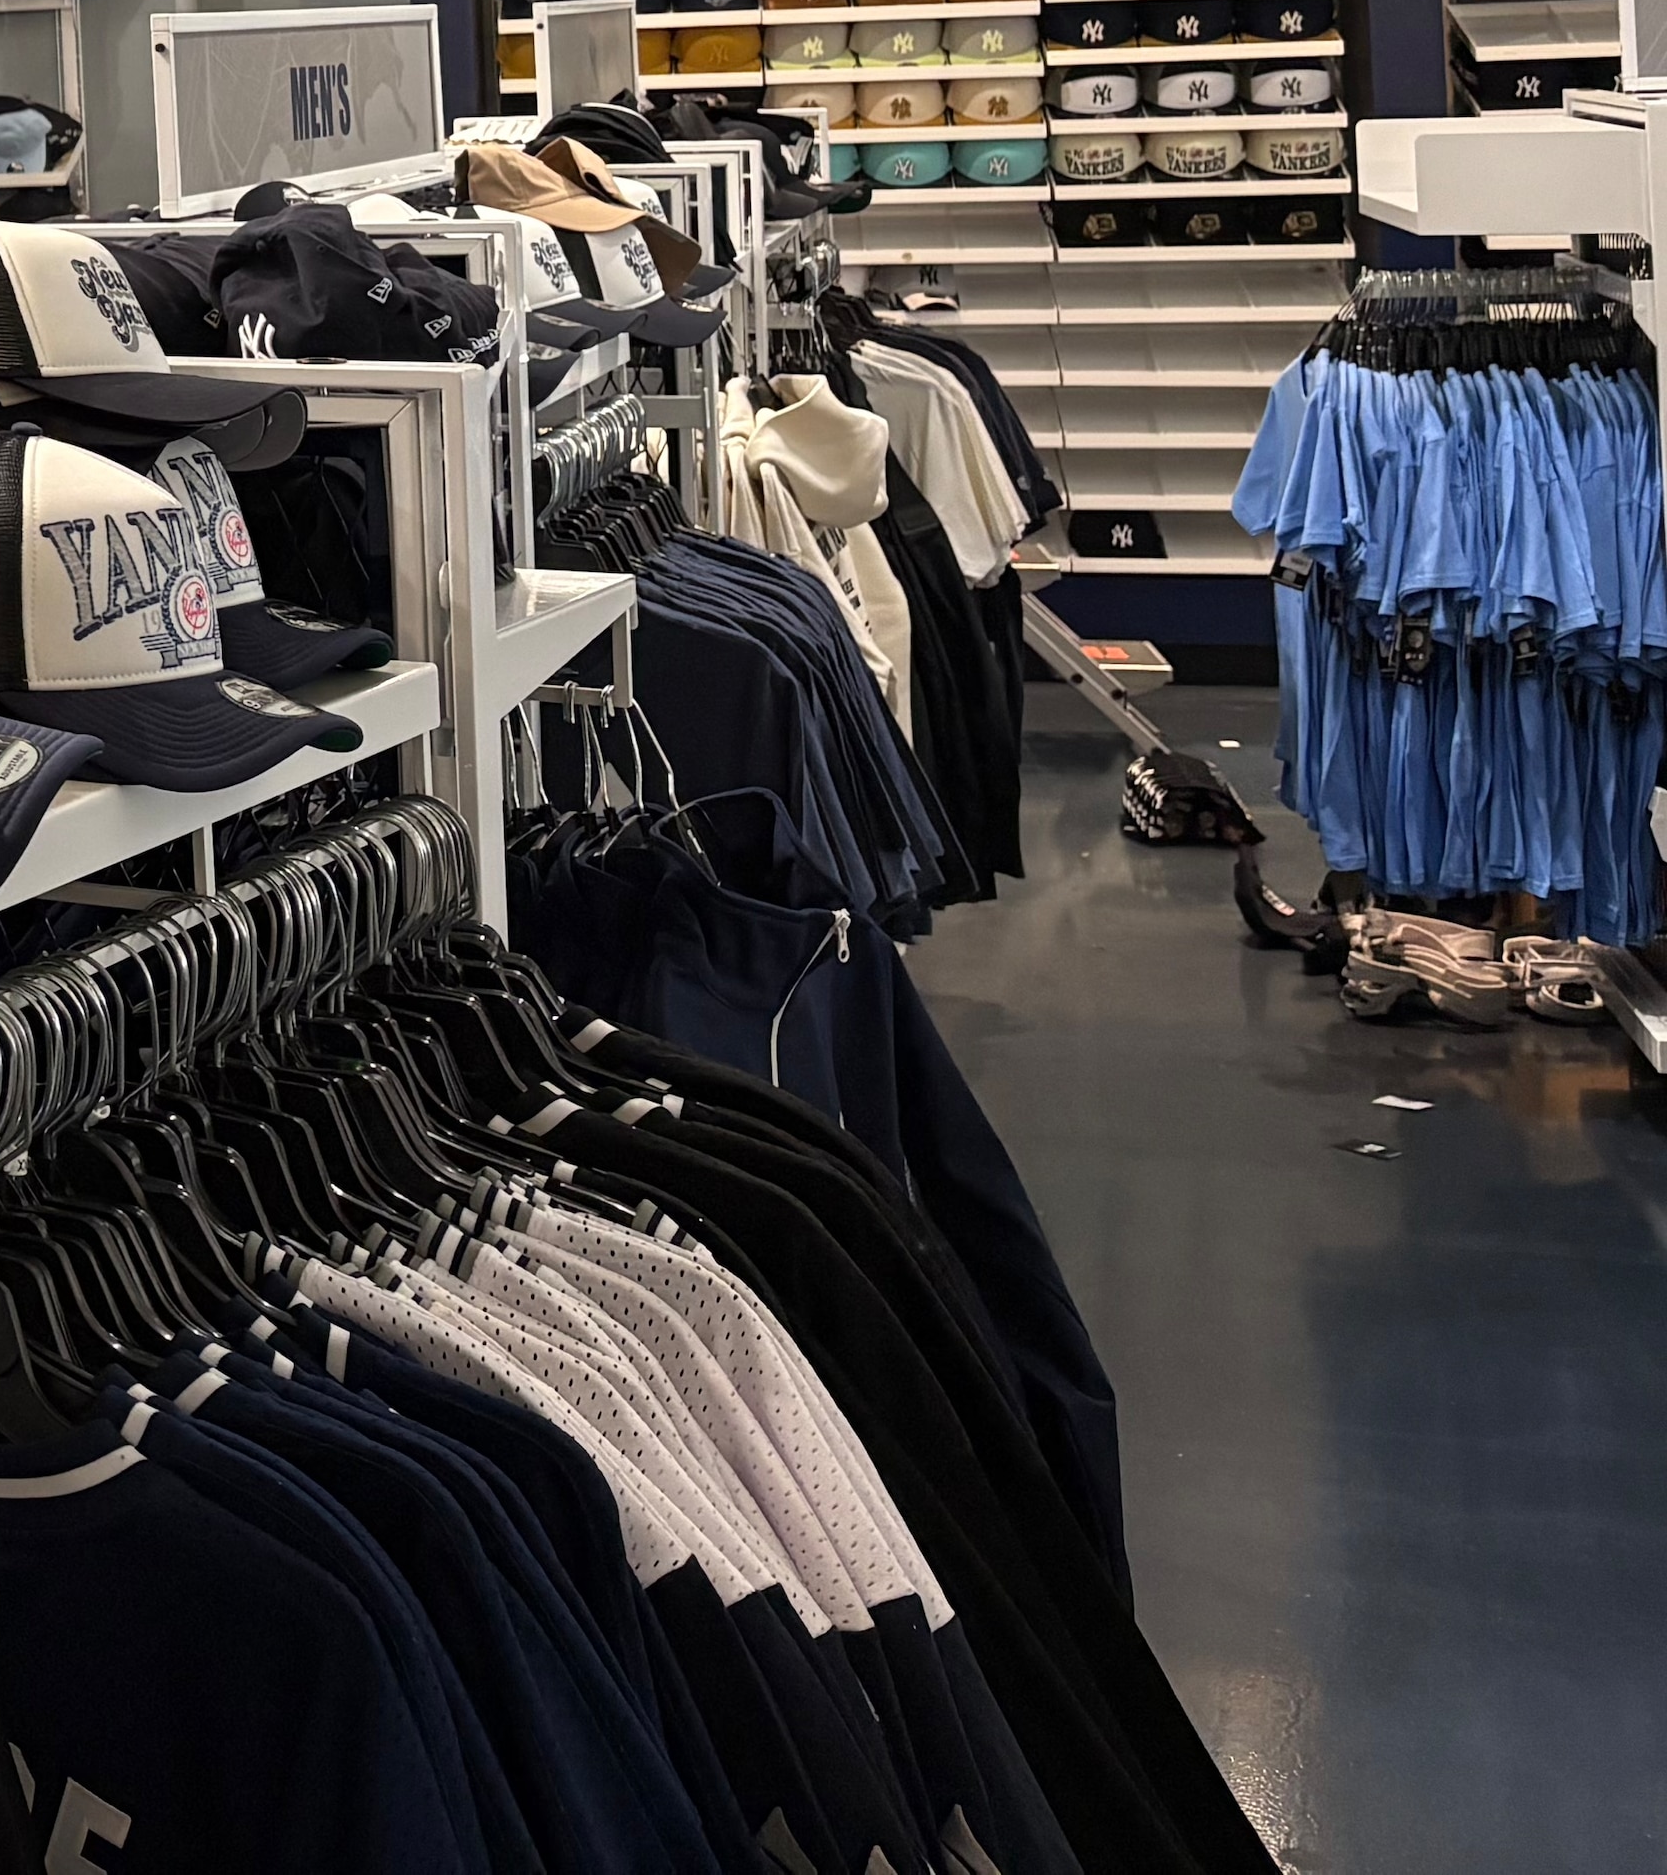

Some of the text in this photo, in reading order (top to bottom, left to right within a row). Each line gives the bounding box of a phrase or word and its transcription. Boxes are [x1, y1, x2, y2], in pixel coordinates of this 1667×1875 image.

[290, 63, 350, 141] MEN'S
[1065, 153, 1124, 175] YANKEES
[1166, 151, 1226, 174] YANKEES
[1270, 147, 1331, 170] YANKEES
[71, 256, 128, 300] New
